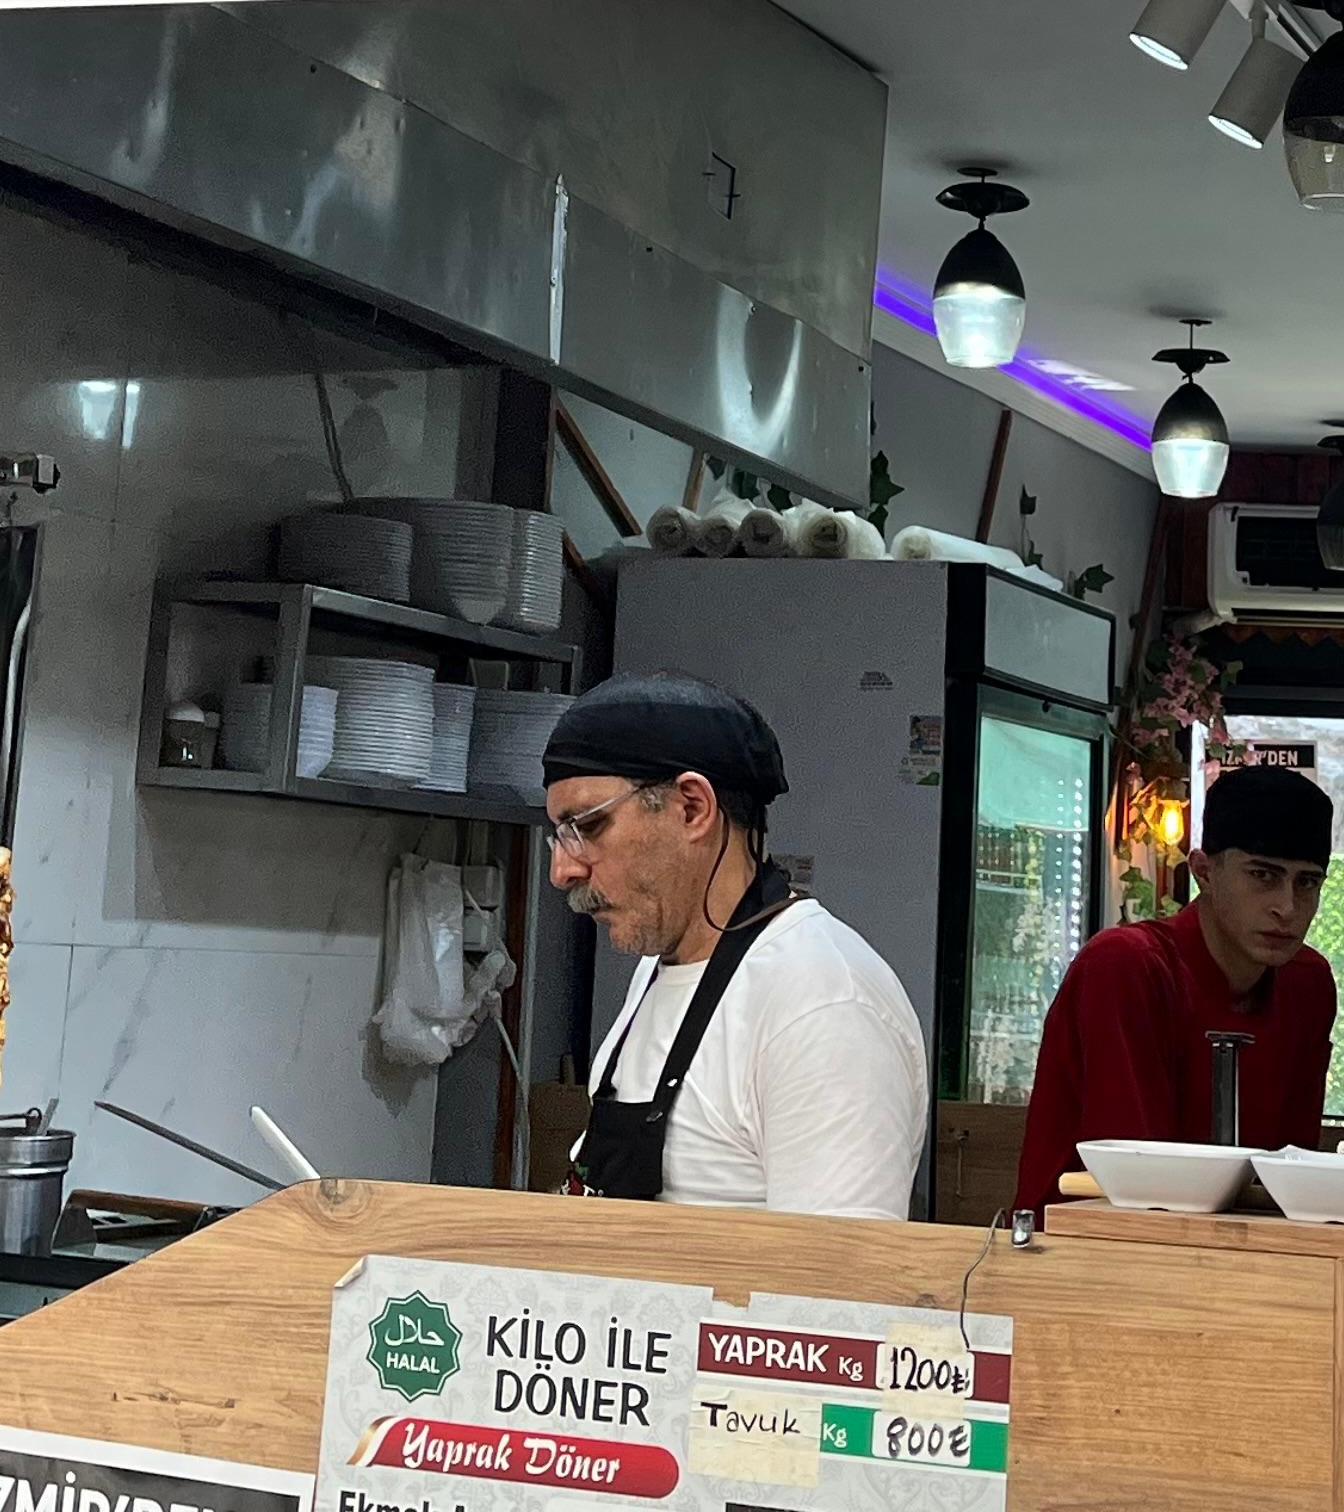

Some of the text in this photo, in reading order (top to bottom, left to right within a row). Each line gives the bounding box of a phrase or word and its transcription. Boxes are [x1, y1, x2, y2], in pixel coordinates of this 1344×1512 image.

[384, 1314, 445, 1346] حلال
[486, 1308, 672, 1374] KİLO İLE
[386, 1351, 440, 1374] HALAL
[707, 1332, 830, 1374] YAPRAK
[838, 1355, 864, 1382] Kg
[494, 1362, 651, 1426] DÖNER
[700, 1401, 801, 1435] Tavuk
[823, 1423, 847, 1448] Kg
[401, 1424, 621, 1483] Yaprak Döner
